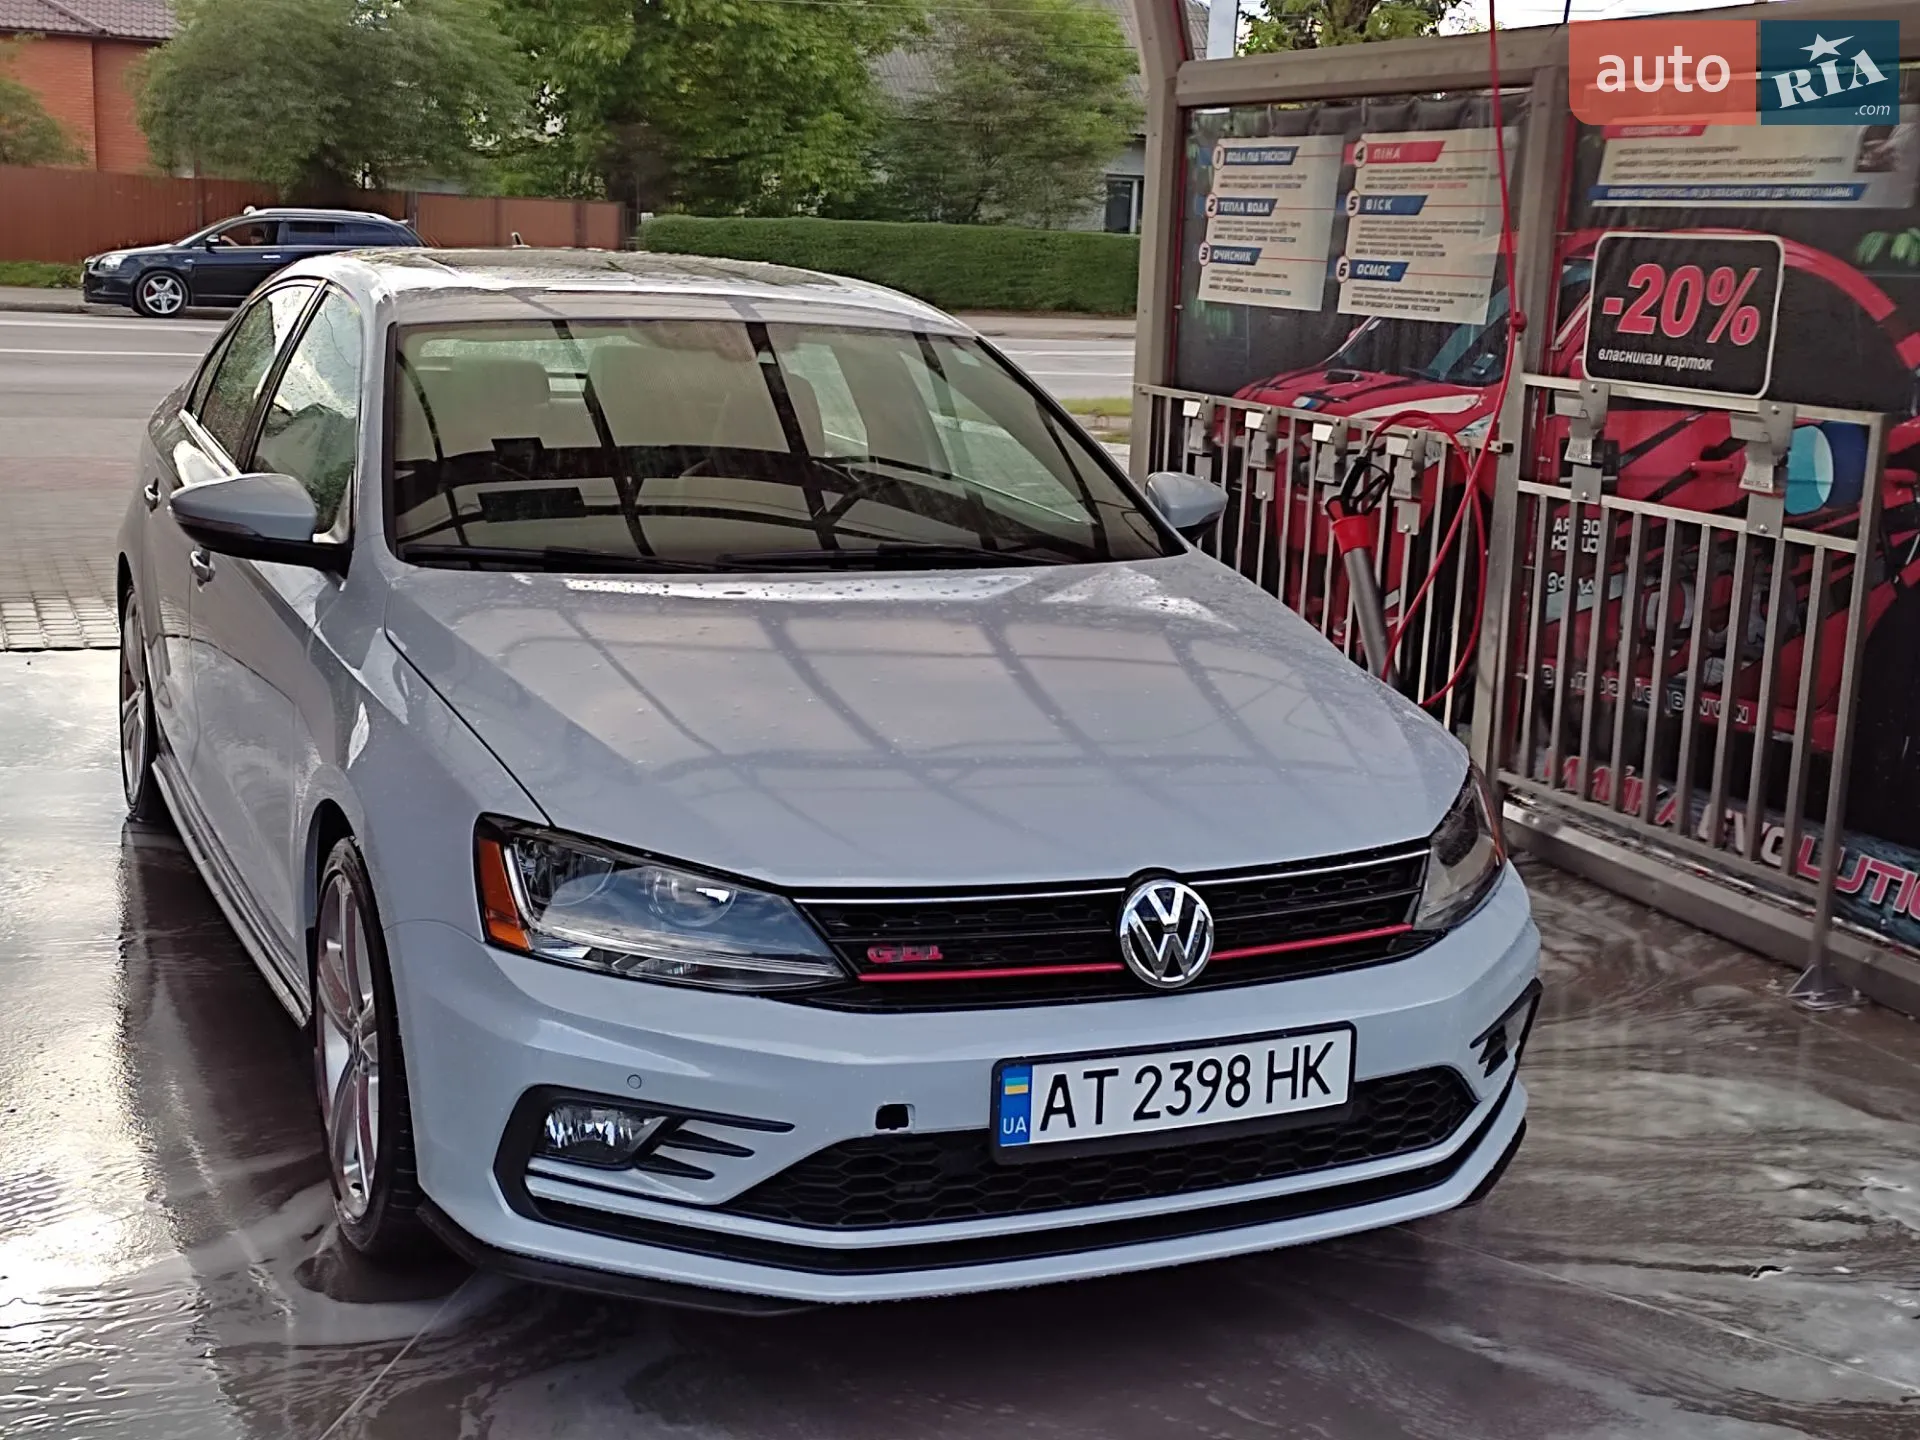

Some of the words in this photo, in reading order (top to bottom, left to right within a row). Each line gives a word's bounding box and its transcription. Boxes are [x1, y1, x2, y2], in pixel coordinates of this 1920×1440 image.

[1355, 147, 1365, 161] 4
[1373, 147, 1401, 160] ПІНА
[1207, 199, 1216, 213] 2
[1219, 201, 1245, 213] ТЕПЛА
[1246, 202, 1270, 213] ВОДА
[1348, 196, 1358, 211] 5
[1365, 199, 1393, 211] ВІСК
[1213, 249, 1253, 262] ОЧИСНИК
[1338, 262, 1348, 276] 6
[1356, 263, 1391, 276] ОСМОС
[1602, 263, 1763, 346] -20%
[1598, 347, 1664, 367] власникам
[1664, 354, 1715, 372] карток
[1038, 1067, 1120, 1132] AT
[1132, 1053, 1252, 1122] 2398
[1265, 1041, 1335, 1104] HK
[1002, 1116, 1027, 1135] UA
